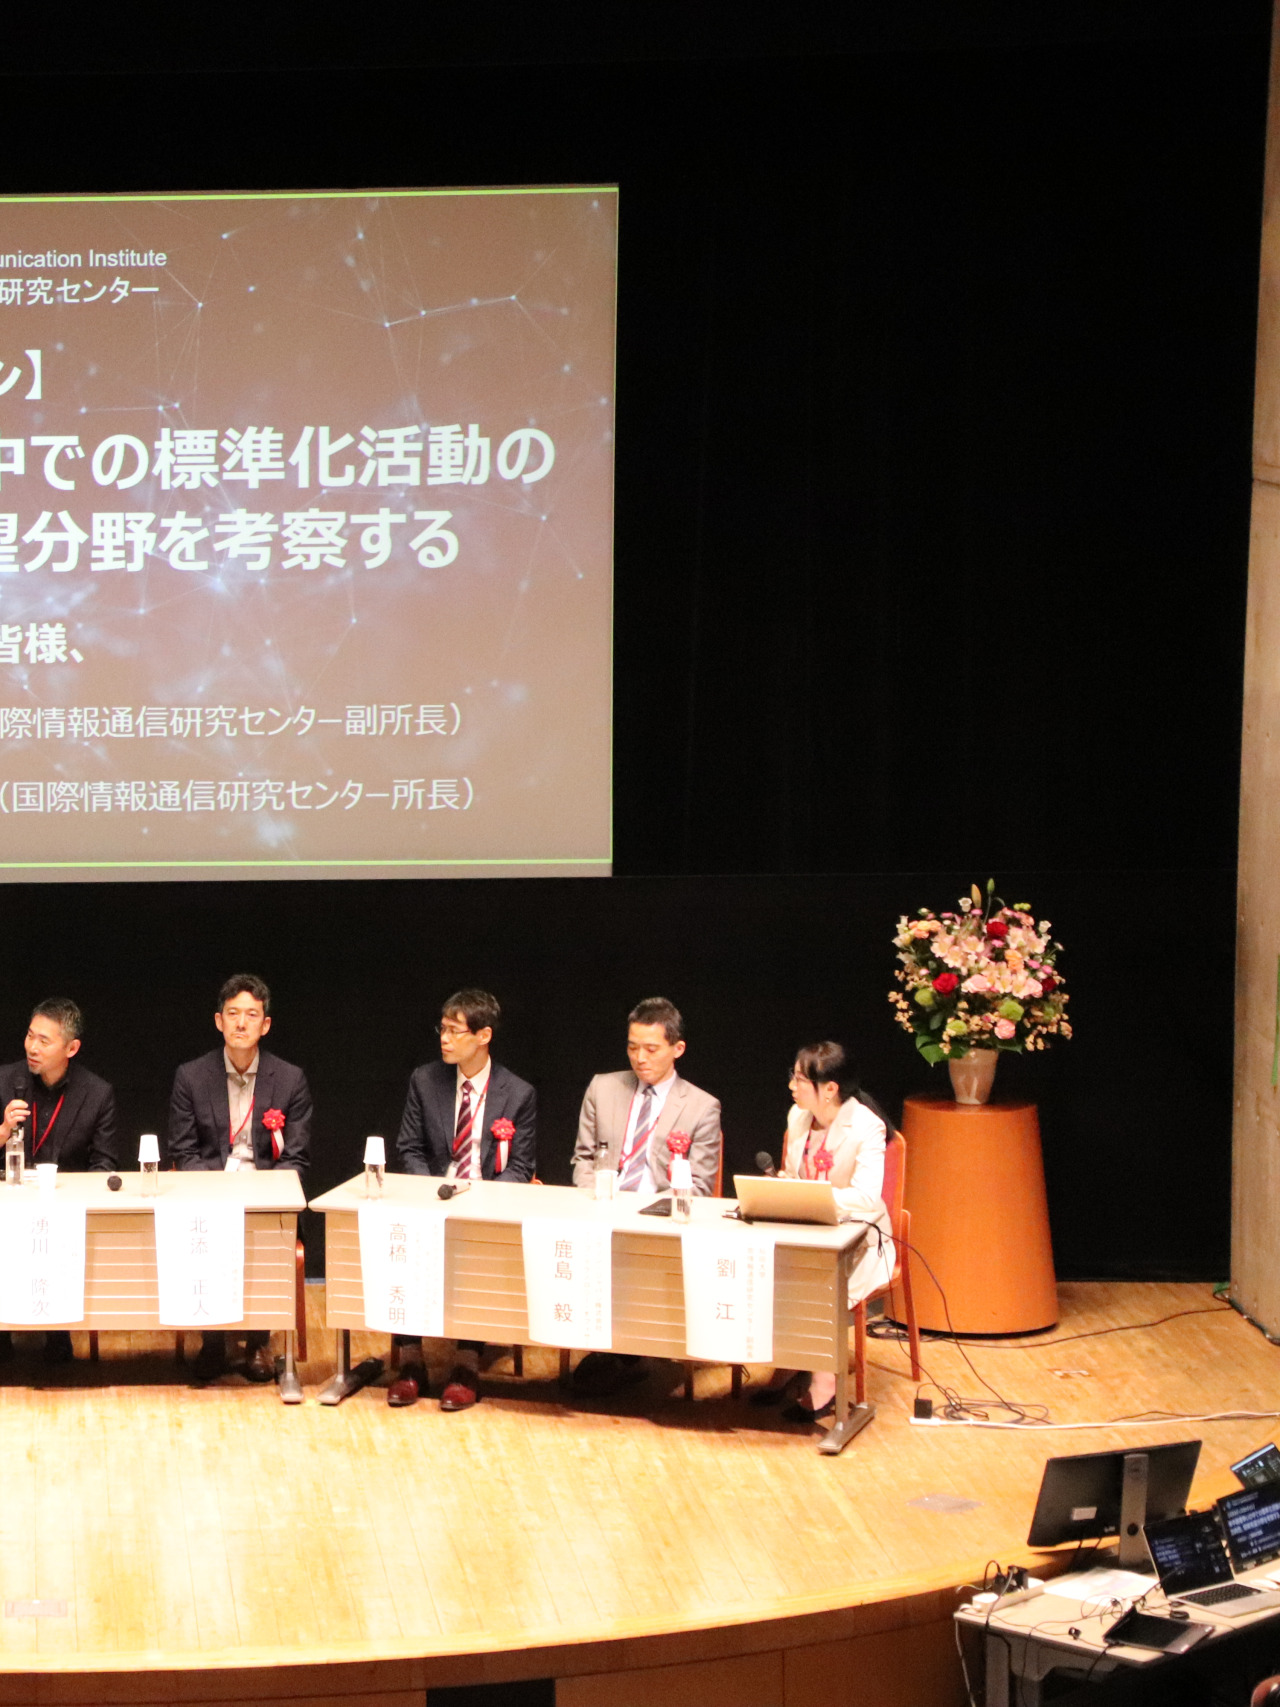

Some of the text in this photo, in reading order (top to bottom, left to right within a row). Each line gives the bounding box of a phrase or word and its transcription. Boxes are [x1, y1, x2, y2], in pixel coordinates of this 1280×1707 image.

[88, 247, 167, 267] Institute
[31, 1217, 50, 1316] 湧川 隆次
[189, 1216, 210, 1316] 北添 正人
[388, 1222, 407, 1326] 高橋 秀明
[553, 1240, 574, 1323] 鹿島 毅
[715, 1259, 736, 1321] 劉 江
